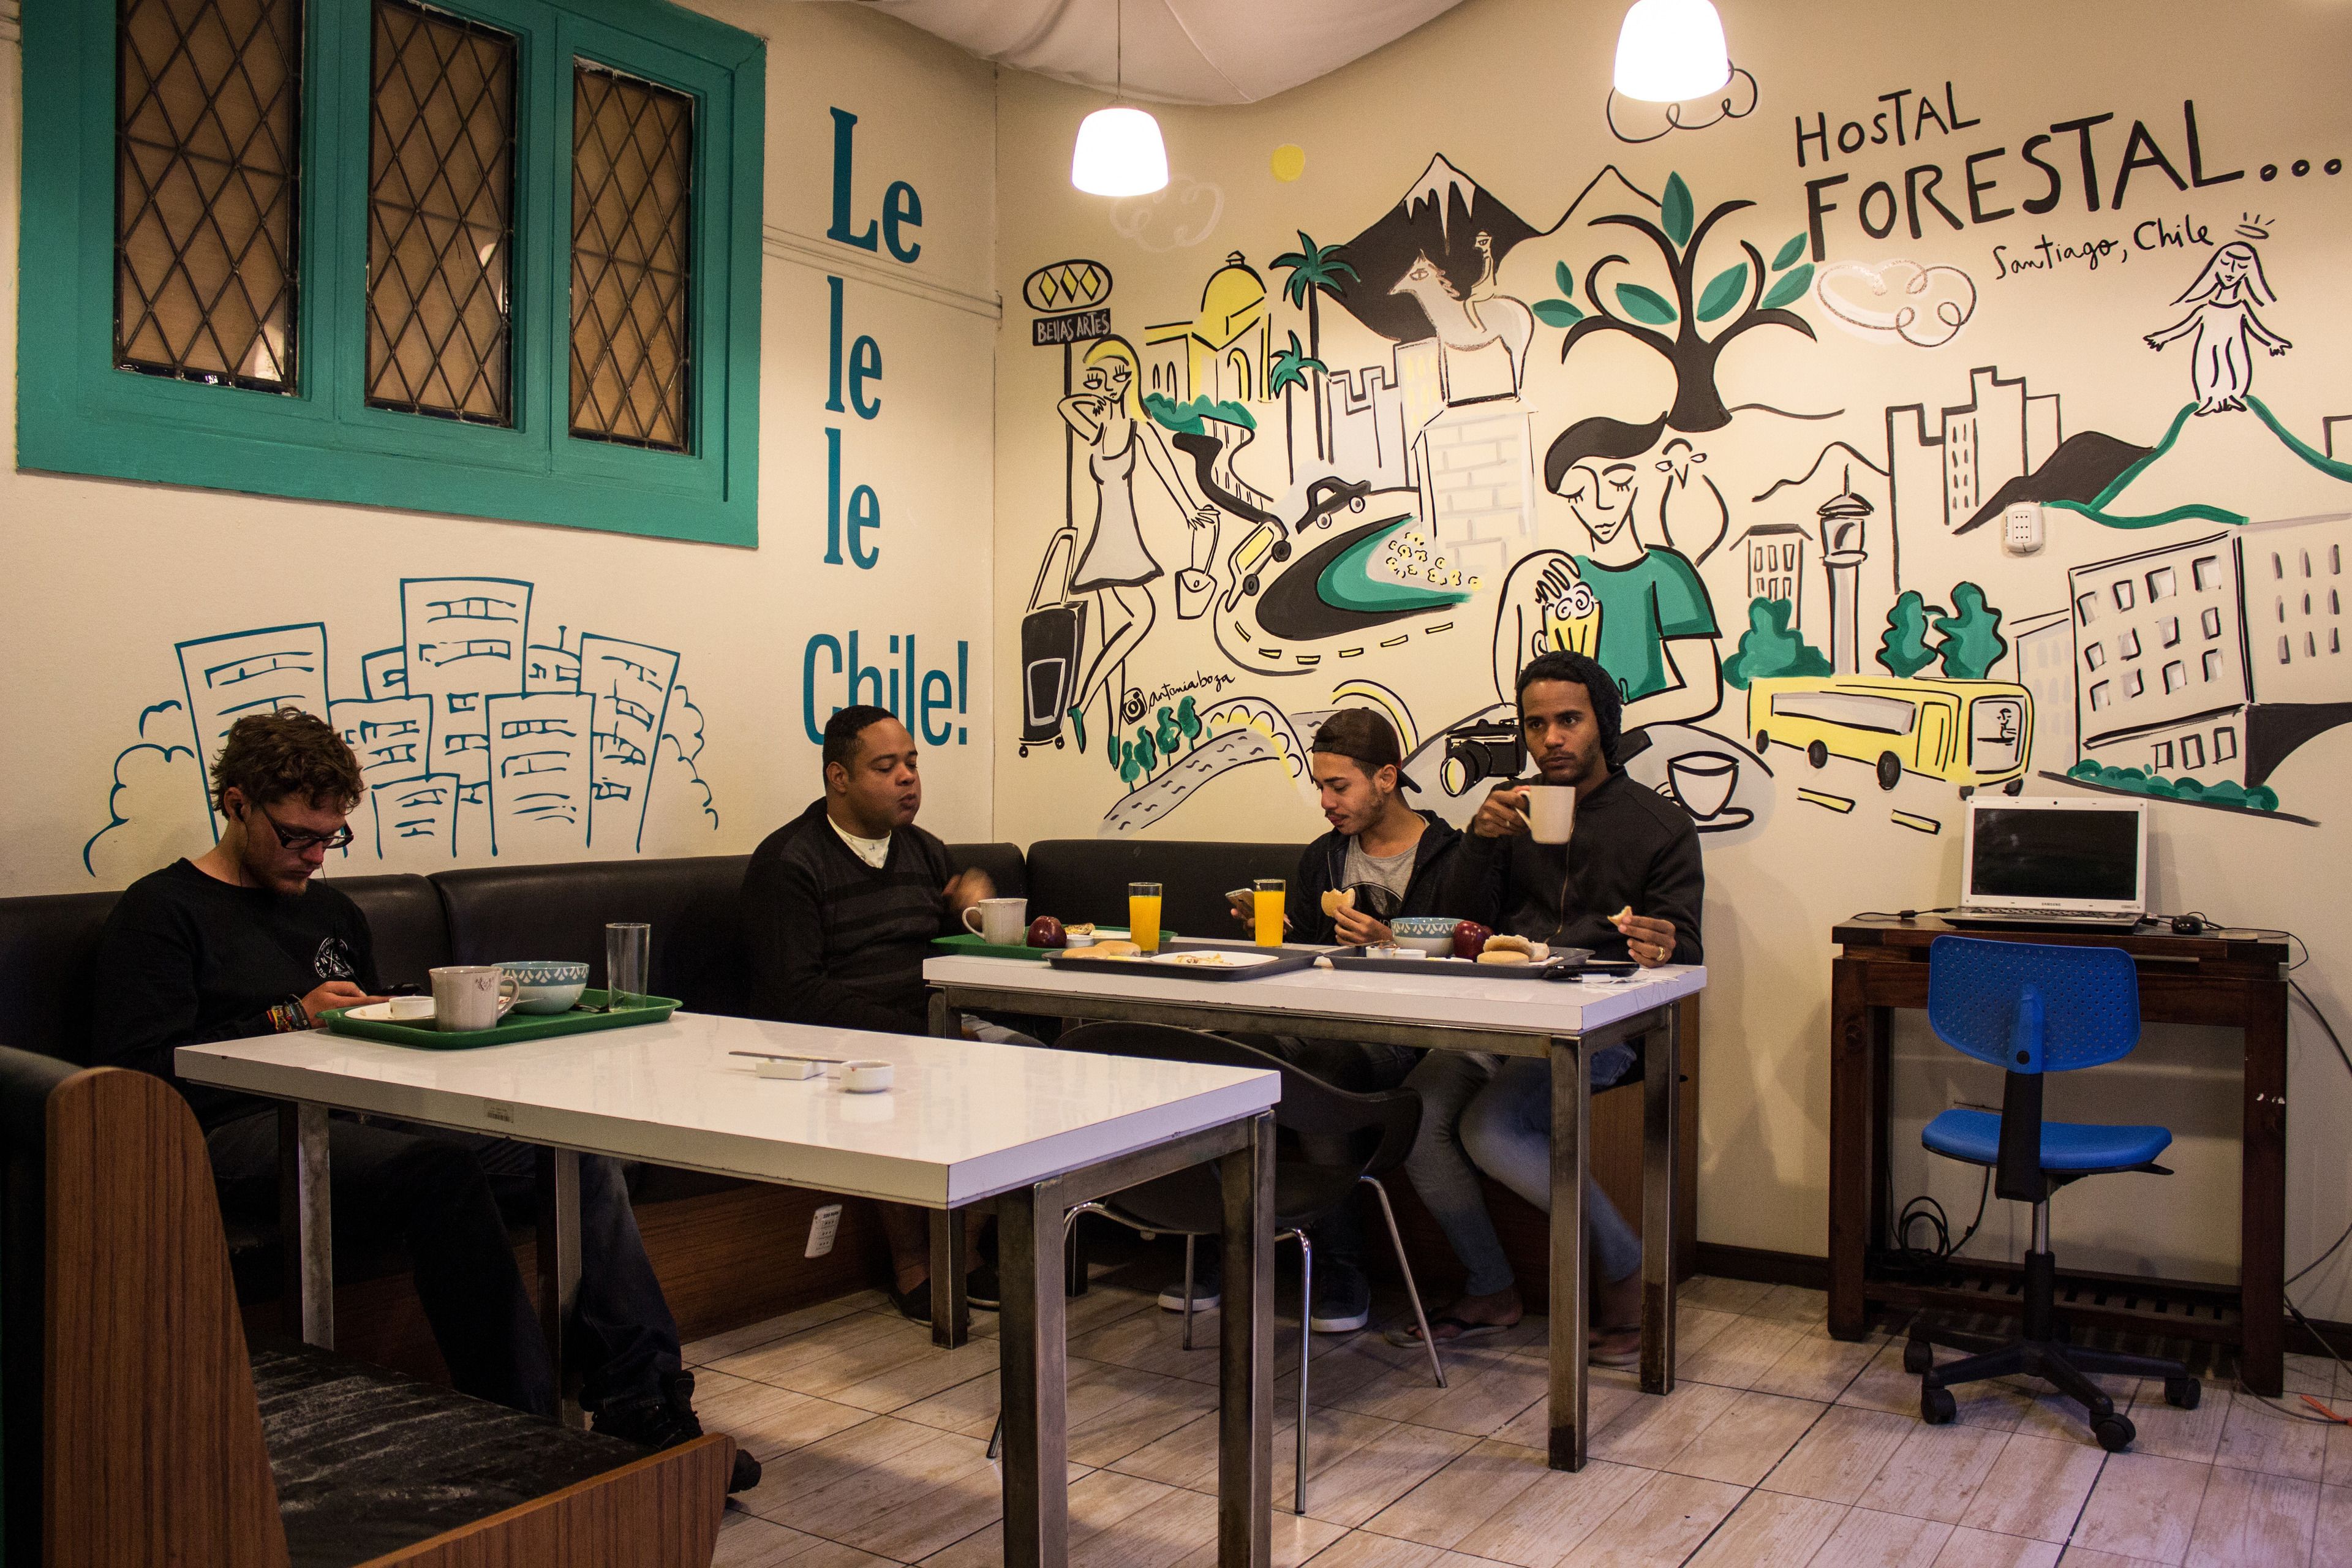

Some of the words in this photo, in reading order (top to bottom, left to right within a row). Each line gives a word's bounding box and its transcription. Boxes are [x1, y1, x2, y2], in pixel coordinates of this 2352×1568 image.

[1795, 81, 1981, 168] HOSTAL
[827, 106, 922, 263] Le
[1992, 234, 2128, 280] Santiago,
[2133, 214, 2214, 251] Chile
[825, 274, 882, 420] le
[1076, 311, 1110, 337] ARTES
[824, 426, 880, 570] le
[803, 629, 968, 746] Chile!
